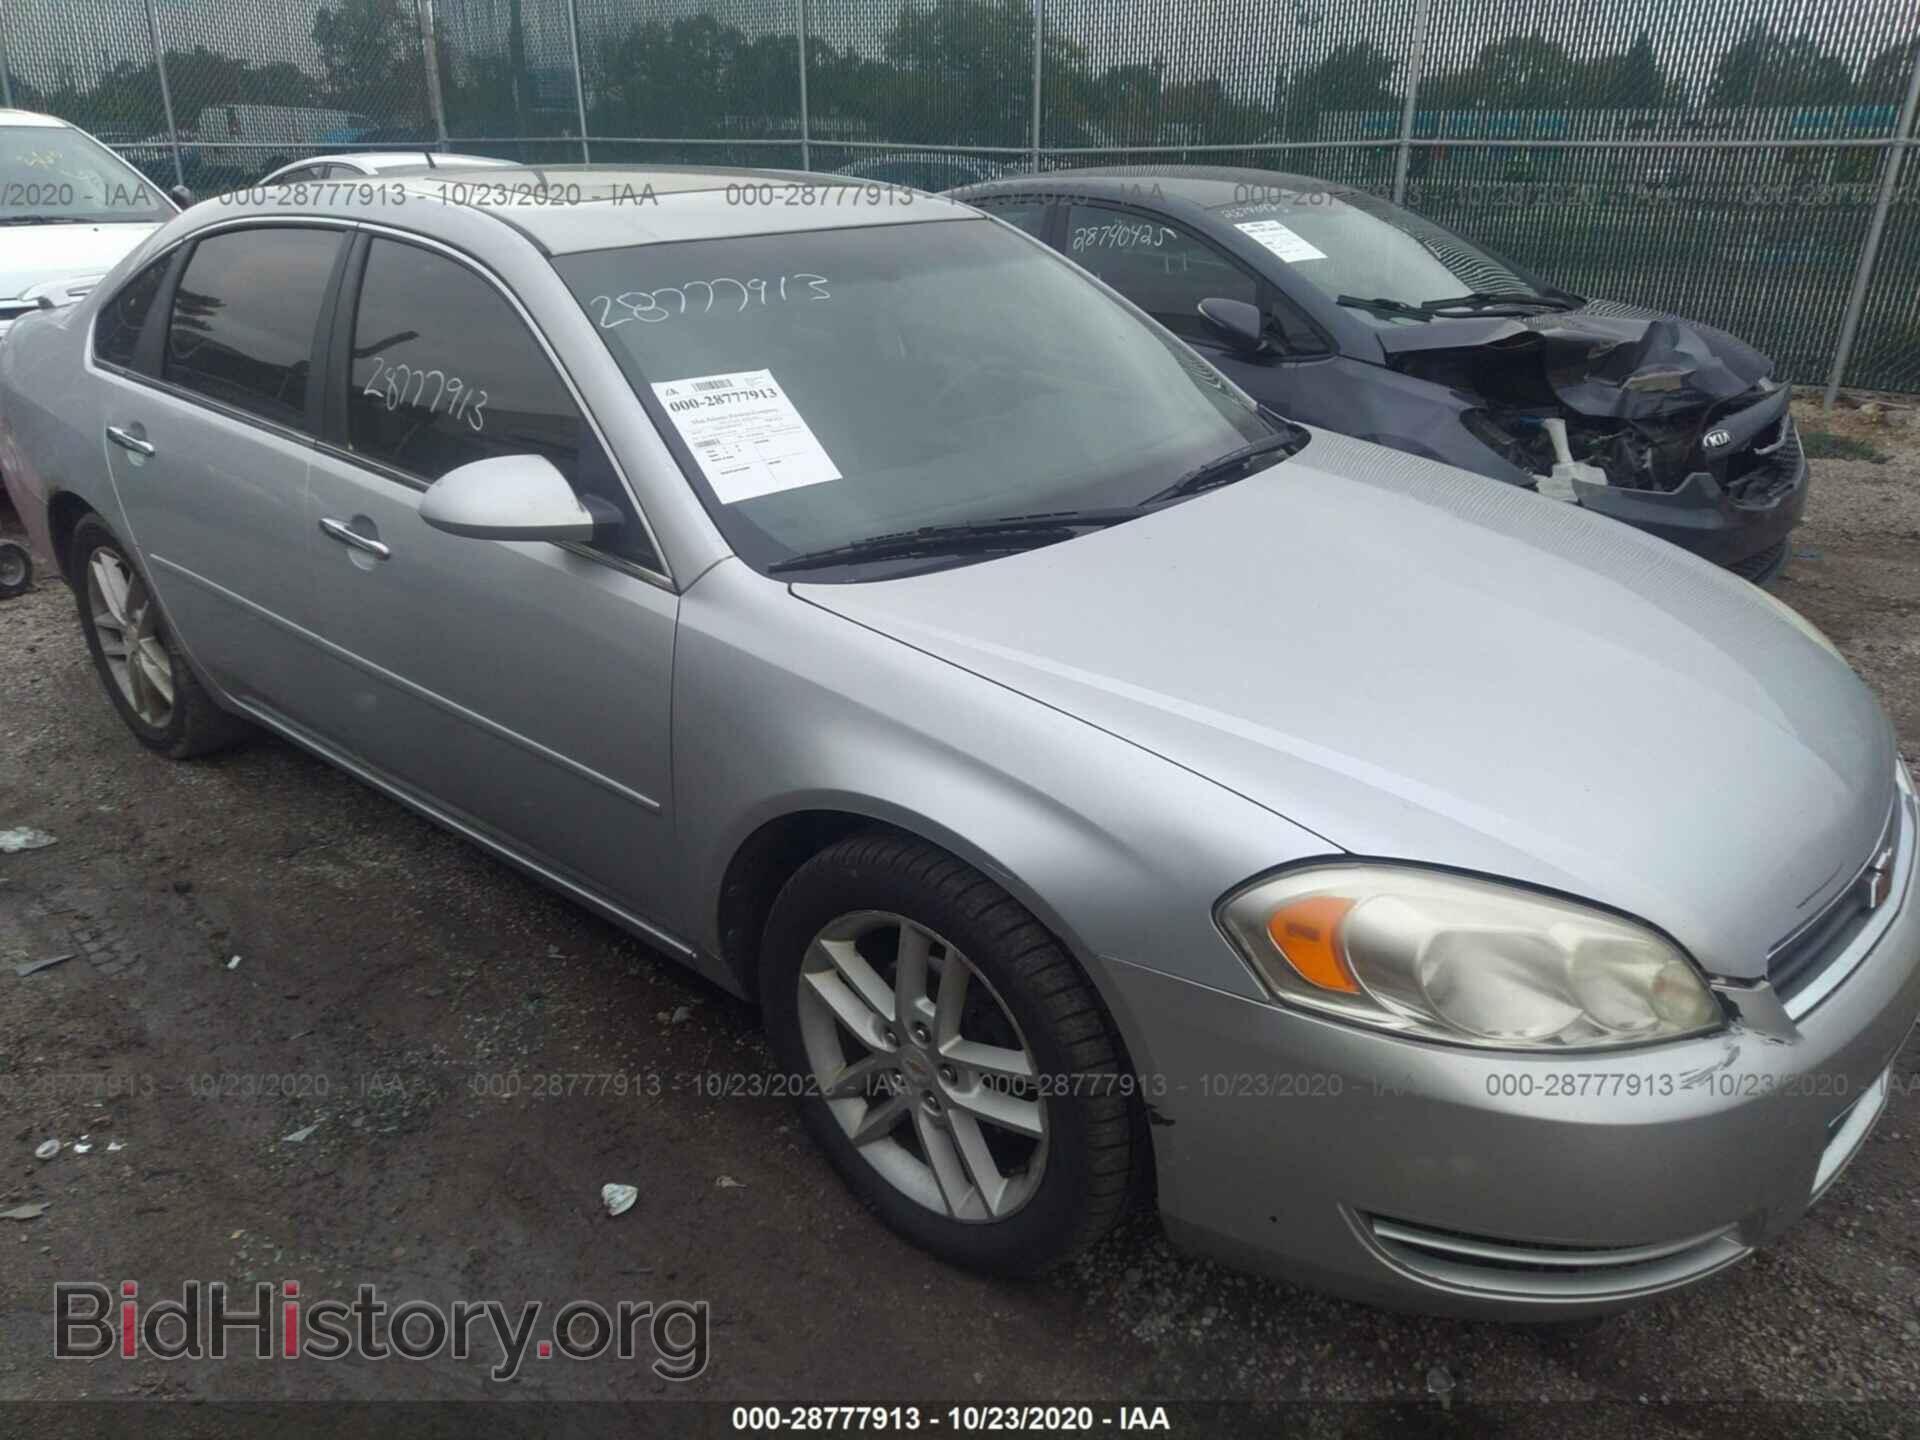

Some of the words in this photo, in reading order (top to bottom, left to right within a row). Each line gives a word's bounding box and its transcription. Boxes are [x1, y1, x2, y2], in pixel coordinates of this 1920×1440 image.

[590, 273, 831, 328] 28777913
[363, 356, 488, 431] 28777913
[669, 388, 778, 413] 000-28777913
[1709, 431, 1730, 448] KIA
